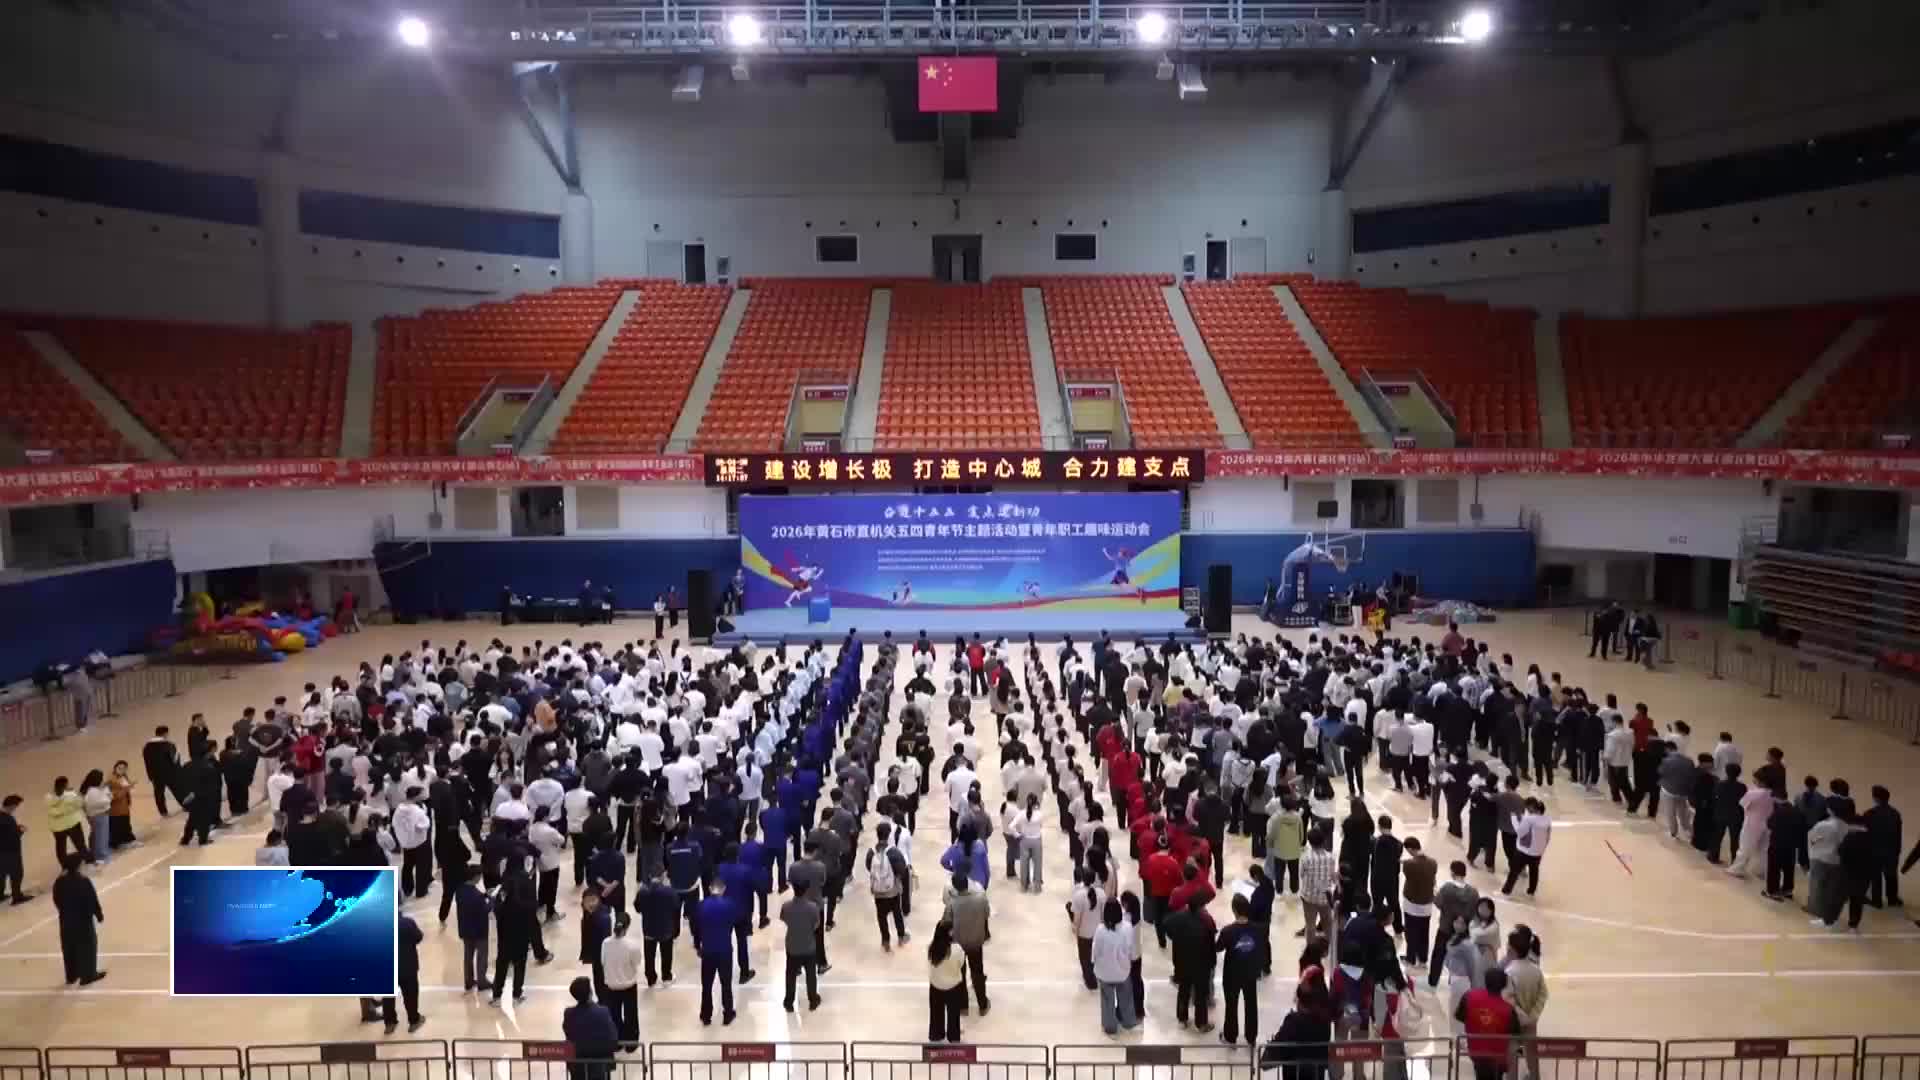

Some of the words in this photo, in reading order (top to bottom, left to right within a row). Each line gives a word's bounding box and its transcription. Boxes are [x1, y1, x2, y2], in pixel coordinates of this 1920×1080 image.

[765, 459, 892, 480] 建设增长极
[914, 458, 1041, 479] 打造中心城
[1063, 457, 1190, 478] 合力建支点
[771, 523, 1151, 539] 2026年黄石市直机关五四青年节主题活动暨青年职工趣味运动会
